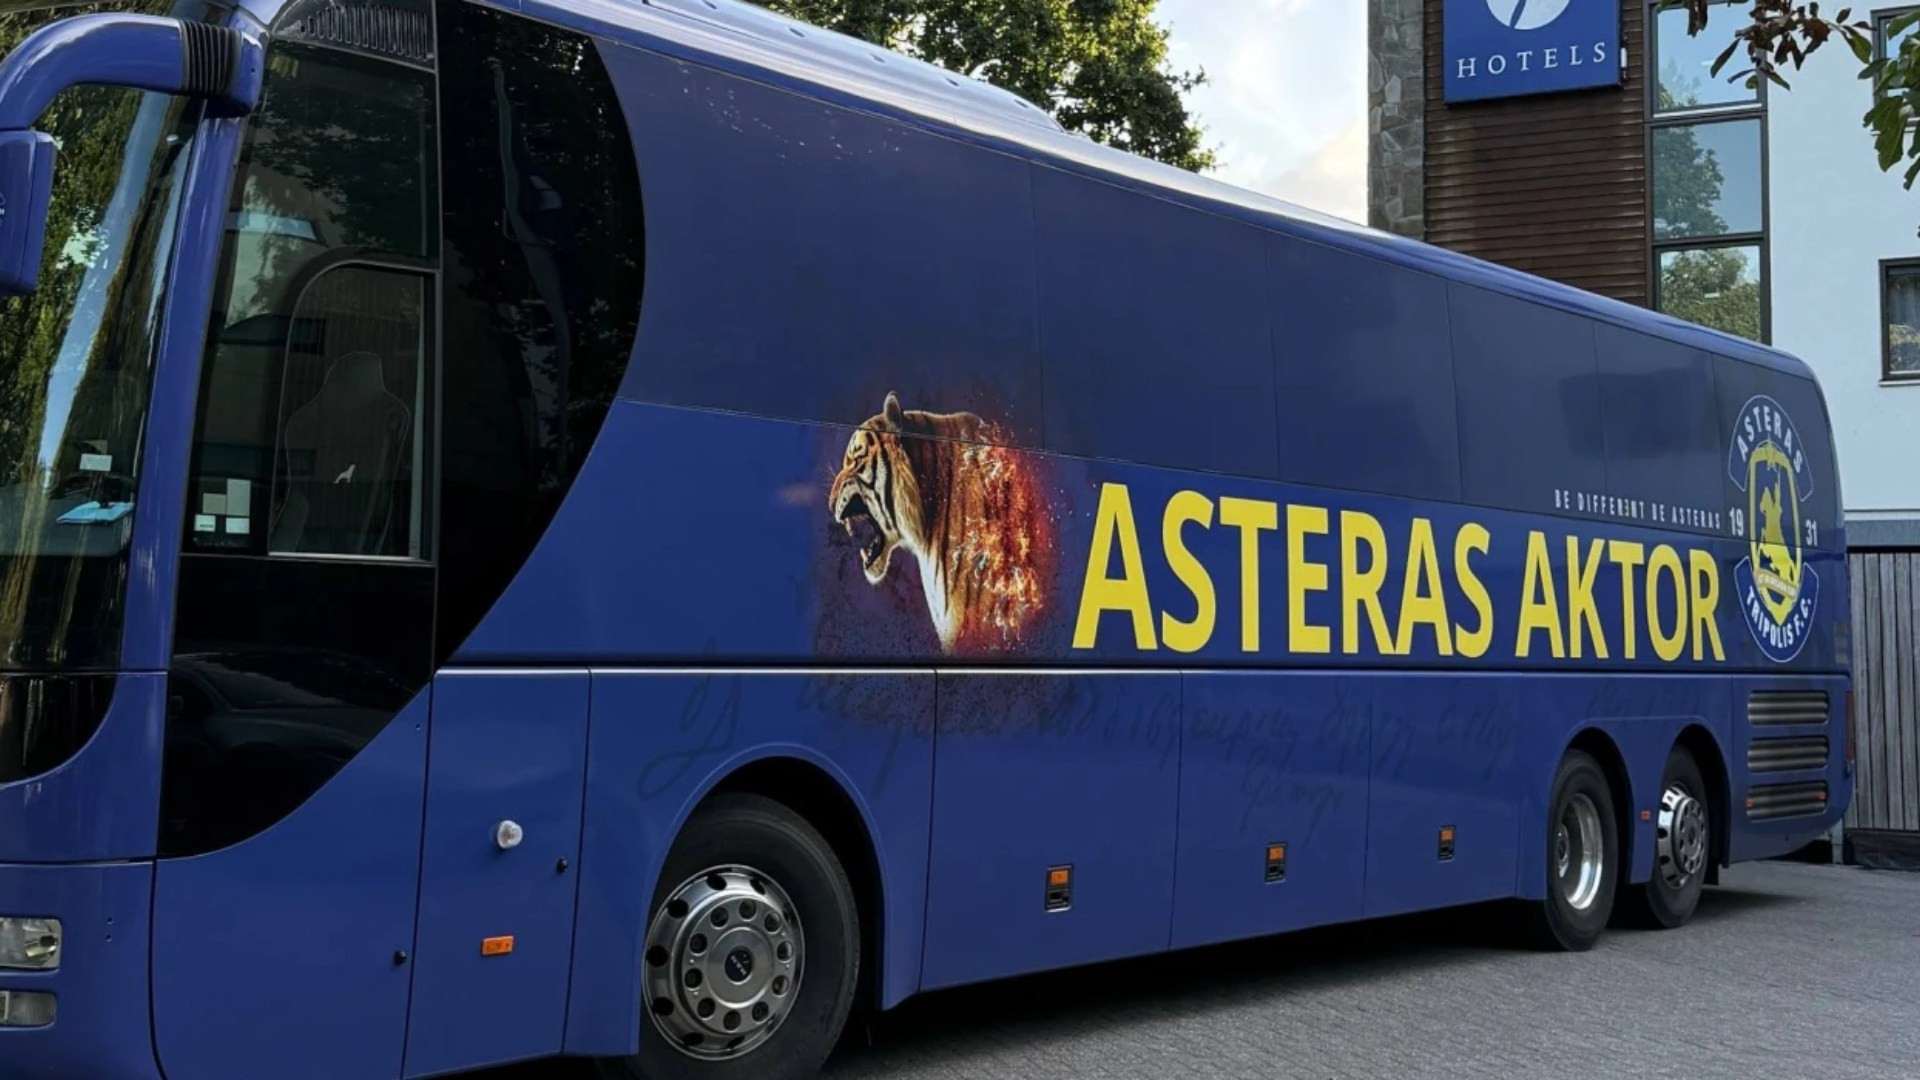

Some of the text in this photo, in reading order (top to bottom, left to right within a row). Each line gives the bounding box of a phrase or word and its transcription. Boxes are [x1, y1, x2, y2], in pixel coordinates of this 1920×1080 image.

[1457, 42, 1606, 78] HOTELS
[1736, 406, 1803, 473] ASTERAS
[1554, 489, 1570, 510] BE
[1651, 502, 1665, 522] BE
[1671, 506, 1720, 530] ASTERAS
[1729, 507, 1744, 536] 19
[1805, 519, 1818, 546] 31
[1072, 482, 1726, 662] ASTERAS AKTOR
[1746, 585, 1794, 649] TRIPOLIS
